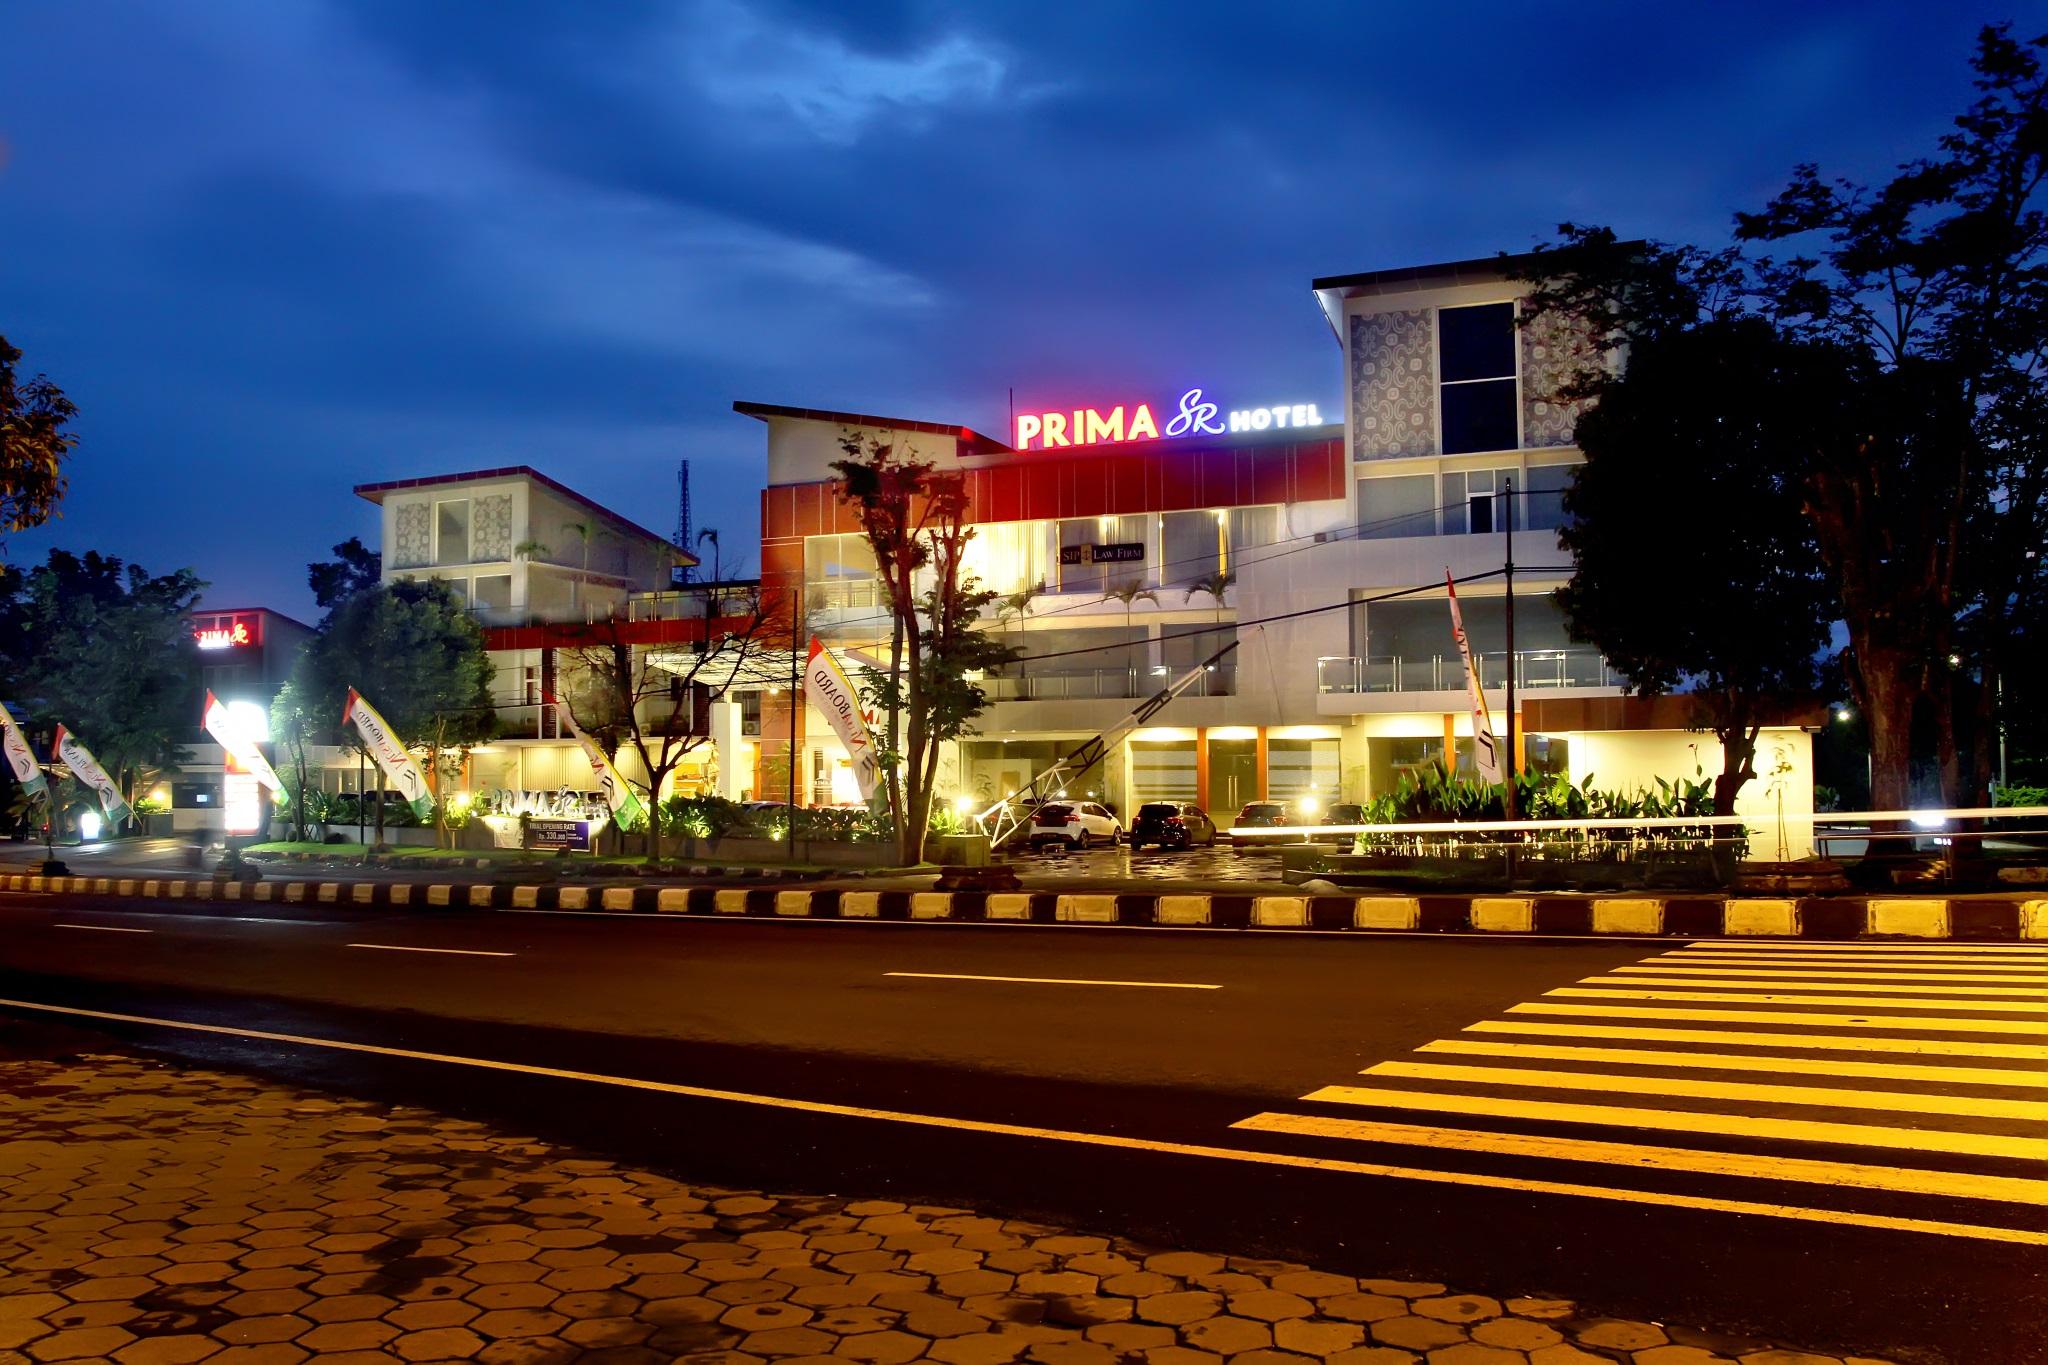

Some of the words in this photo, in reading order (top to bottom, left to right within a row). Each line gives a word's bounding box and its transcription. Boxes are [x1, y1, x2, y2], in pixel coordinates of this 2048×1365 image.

[1017, 404, 1160, 450] PRIMA
[1230, 404, 1323, 432] HOTEL
[491, 789, 552, 817] PRIMA
[563, 823, 576, 831] RATE
